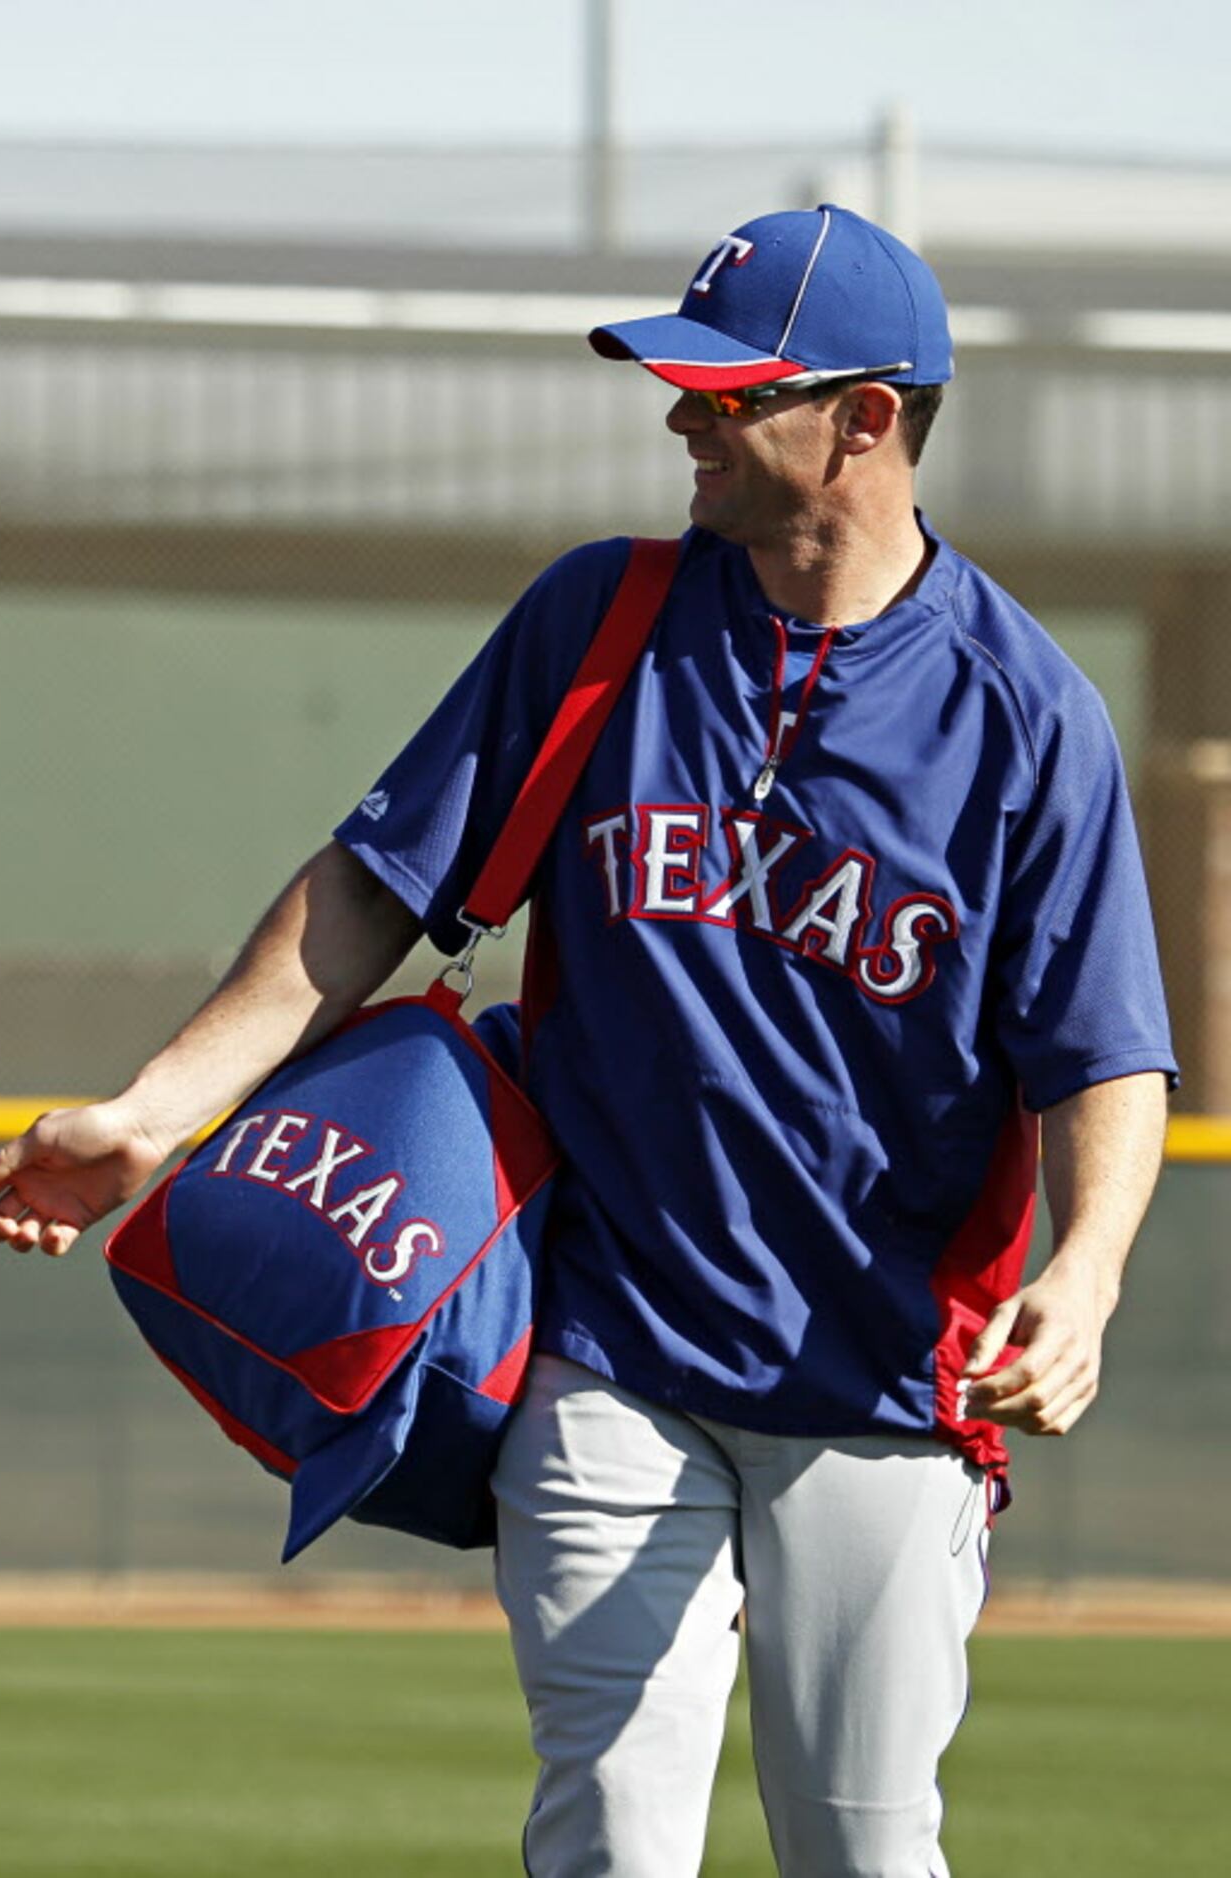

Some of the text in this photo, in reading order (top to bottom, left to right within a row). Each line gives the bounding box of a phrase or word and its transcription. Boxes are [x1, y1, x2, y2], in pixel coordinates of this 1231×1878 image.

[690, 233, 756, 296] T
[581, 803, 958, 1004] TEXAS
[208, 1109, 445, 1287] TEXAS
